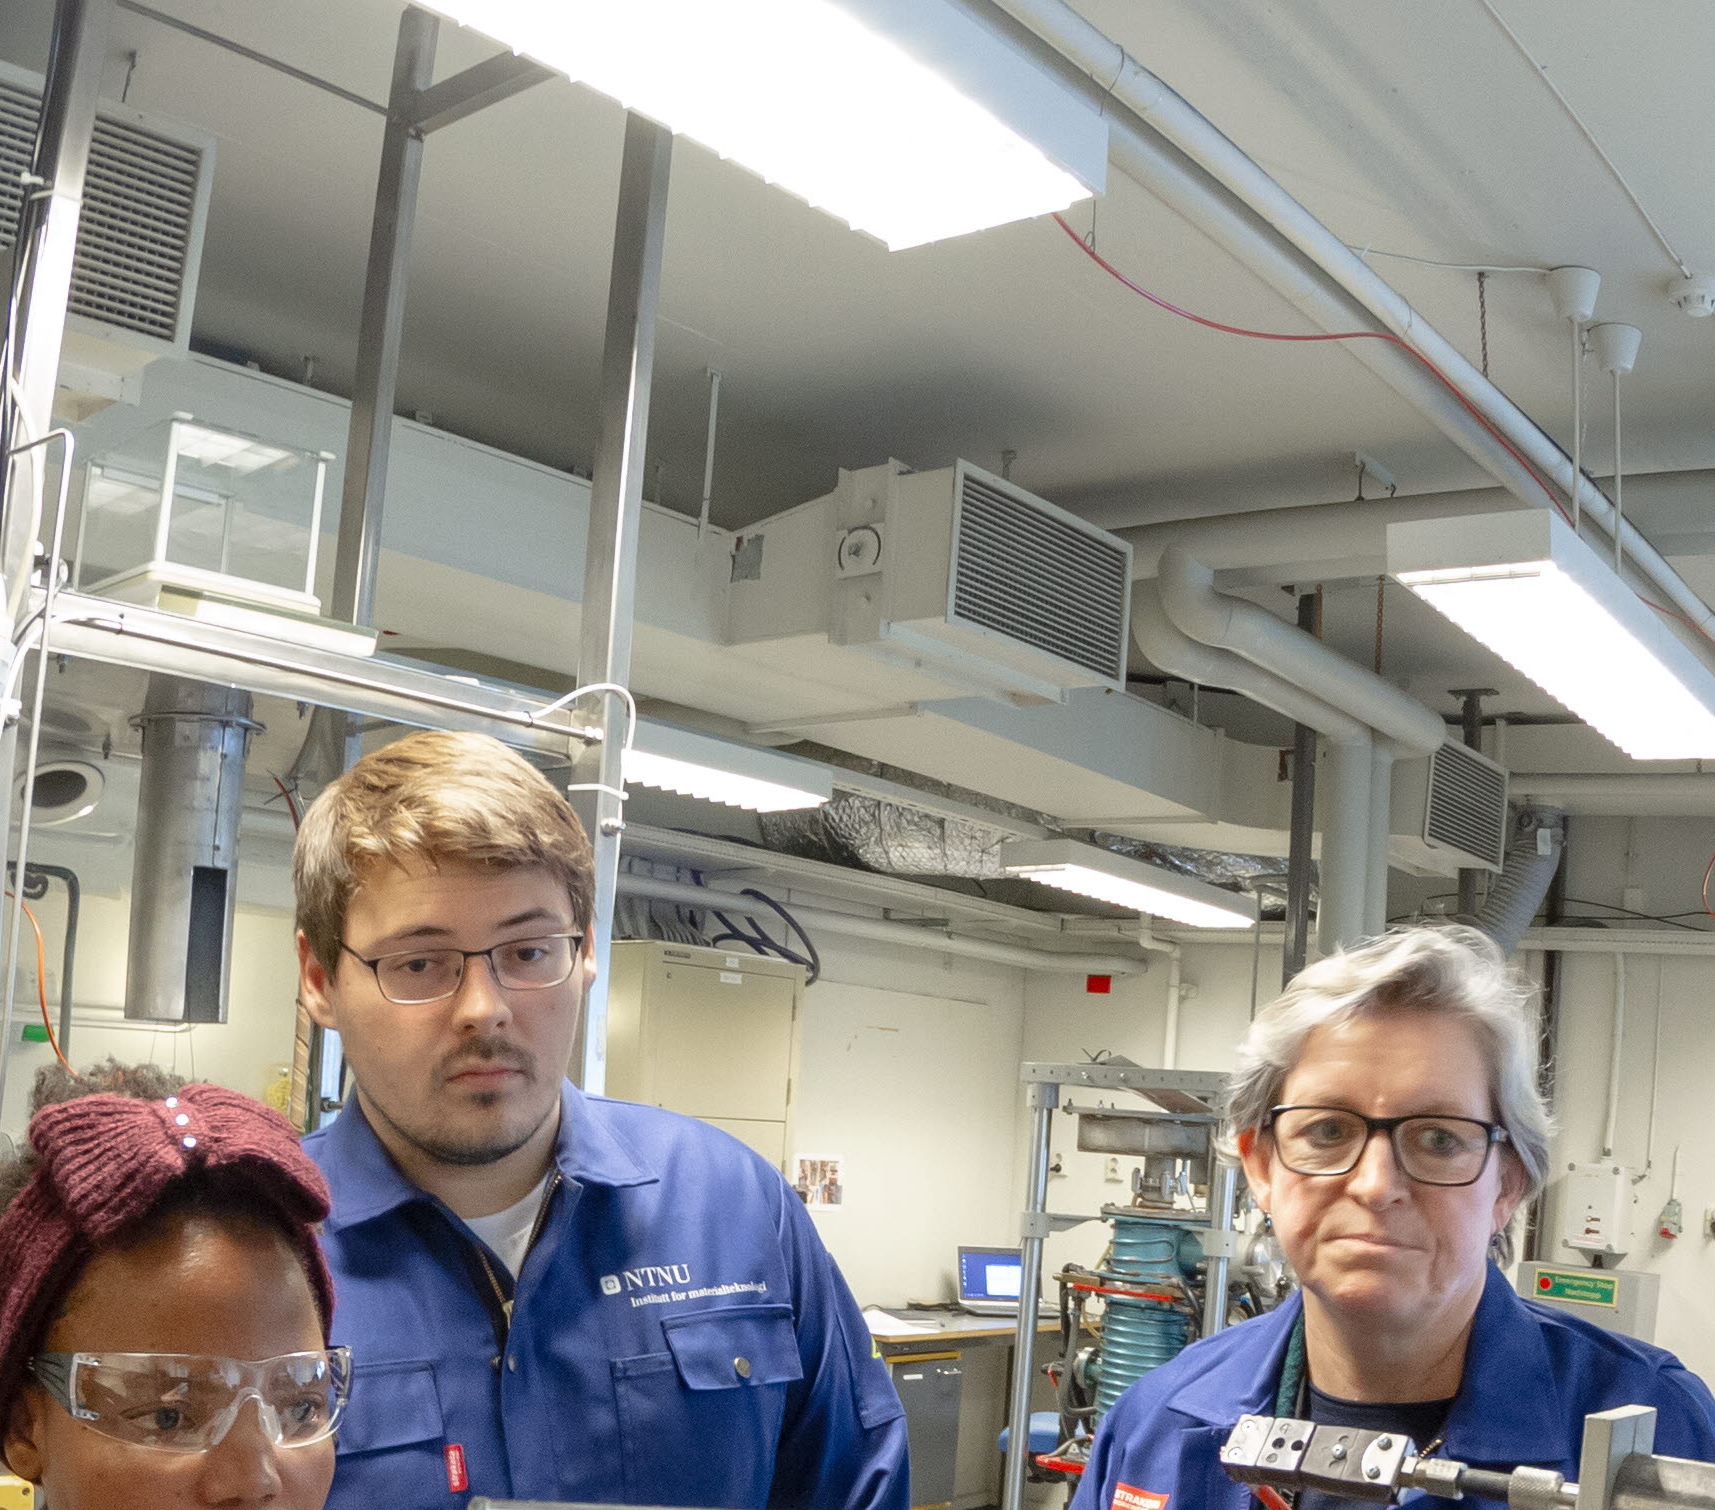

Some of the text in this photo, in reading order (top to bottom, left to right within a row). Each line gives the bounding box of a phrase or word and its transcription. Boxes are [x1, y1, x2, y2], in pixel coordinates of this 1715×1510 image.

[622, 1263, 691, 1291] NTNU
[630, 1293, 671, 1308] Institutt
[670, 1291, 687, 1302] for
